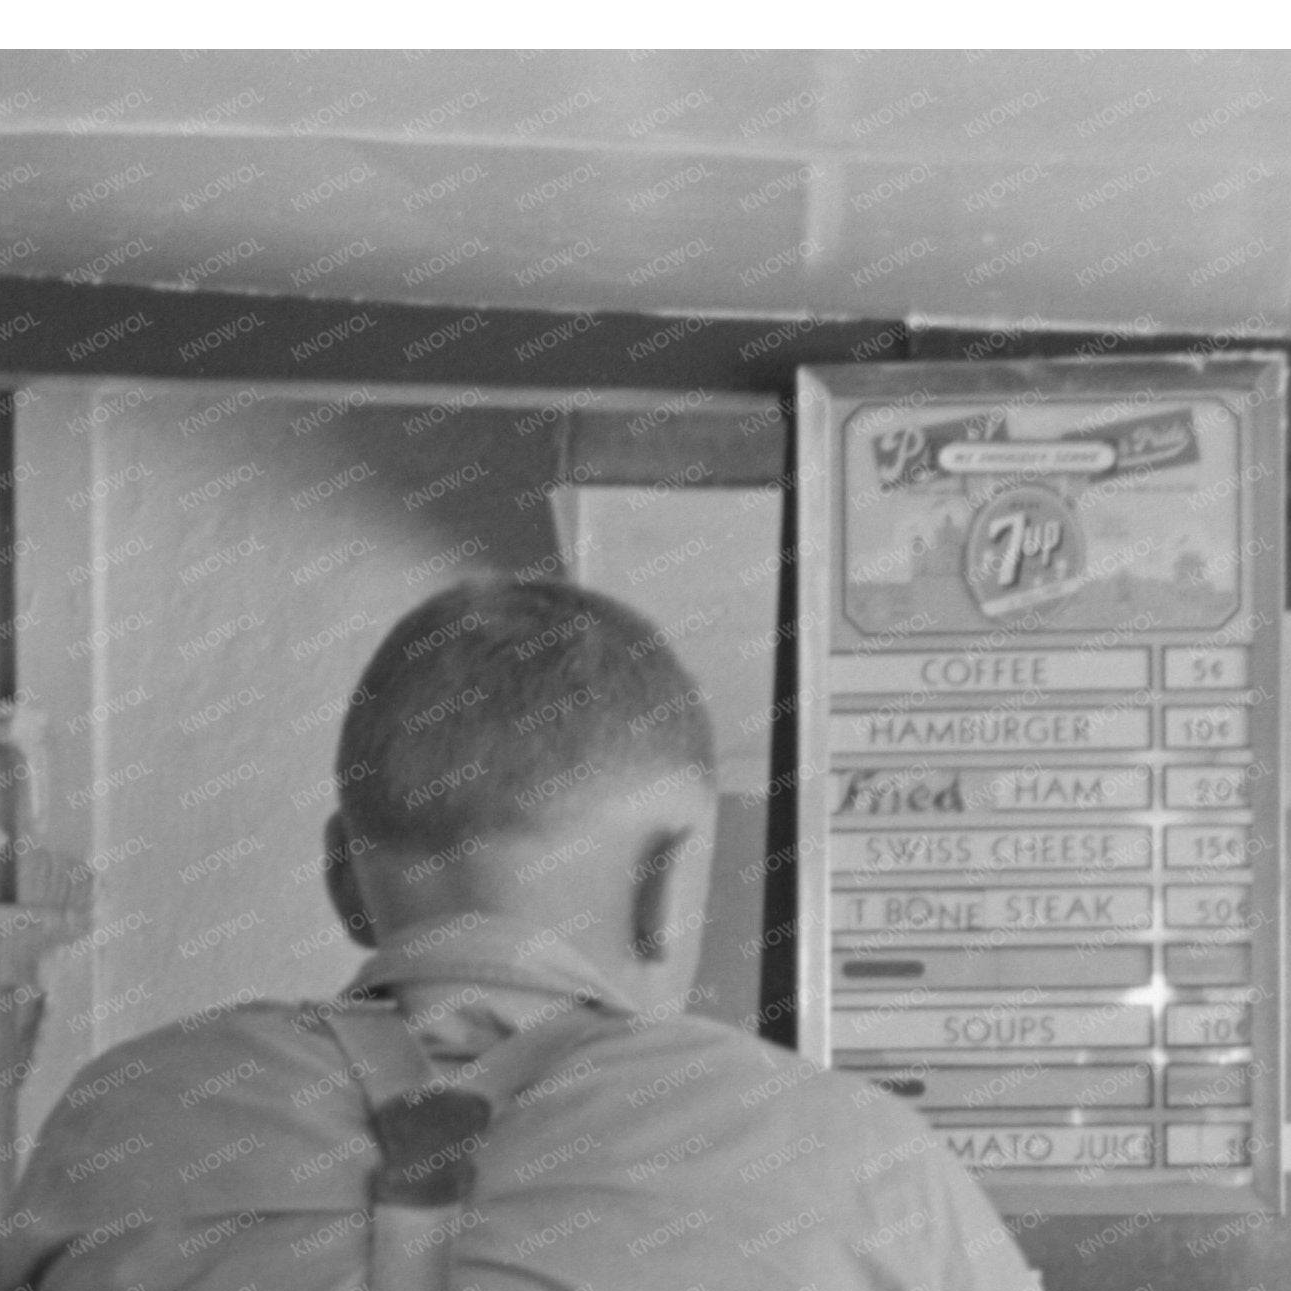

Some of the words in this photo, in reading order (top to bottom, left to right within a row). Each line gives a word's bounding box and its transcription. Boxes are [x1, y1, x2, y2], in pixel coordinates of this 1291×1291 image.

[989, 511, 1062, 586] 7up
[920, 657, 1048, 687] COFFEE
[1191, 657, 1225, 682] 5¢
[869, 715, 1091, 745] HAMBURGER
[1182, 718, 1231, 742] 10¢
[834, 769, 965, 816] Fried
[1014, 777, 1104, 804] HAM
[865, 836, 972, 865] SWISS
[992, 834, 1116, 863] CHEESE
[851, 897, 866, 924] T
[885, 896, 982, 930] BONE
[1007, 895, 1114, 923] STEAK
[943, 1016, 1055, 1044] SOUPS
[946, 1133, 1053, 1162] MATO
